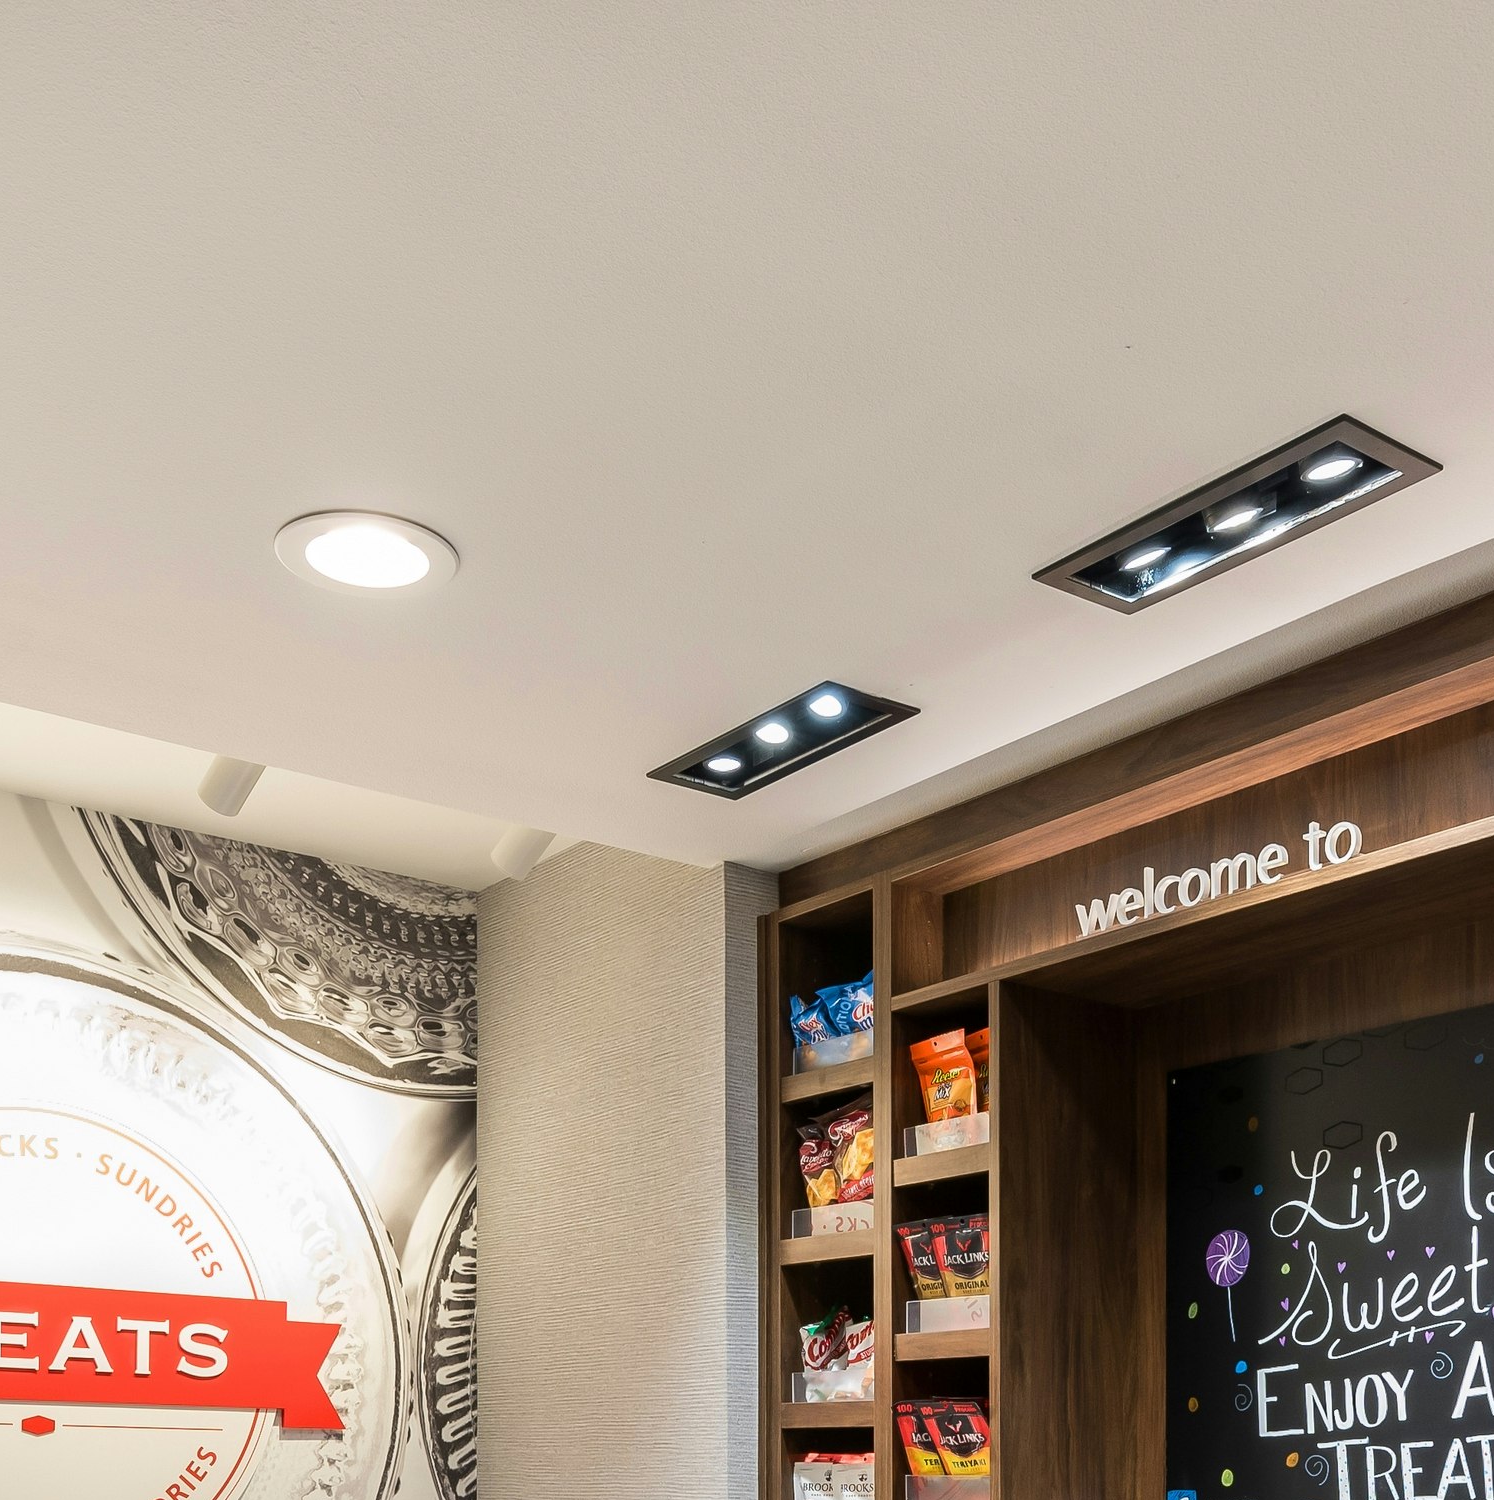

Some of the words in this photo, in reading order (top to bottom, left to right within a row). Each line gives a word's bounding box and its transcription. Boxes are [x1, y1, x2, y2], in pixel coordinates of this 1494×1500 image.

[1075, 843, 1288, 936] welcome
[1302, 821, 1362, 871] to
[95, 1153, 225, 1279] SUNDRIES
[1270, 1130, 1427, 1243] Life
[944, 1253, 964, 1266] JACK
[955, 1280, 989, 1290] ORIGINAL
[1256, 1363, 1414, 1437] ENJOY
